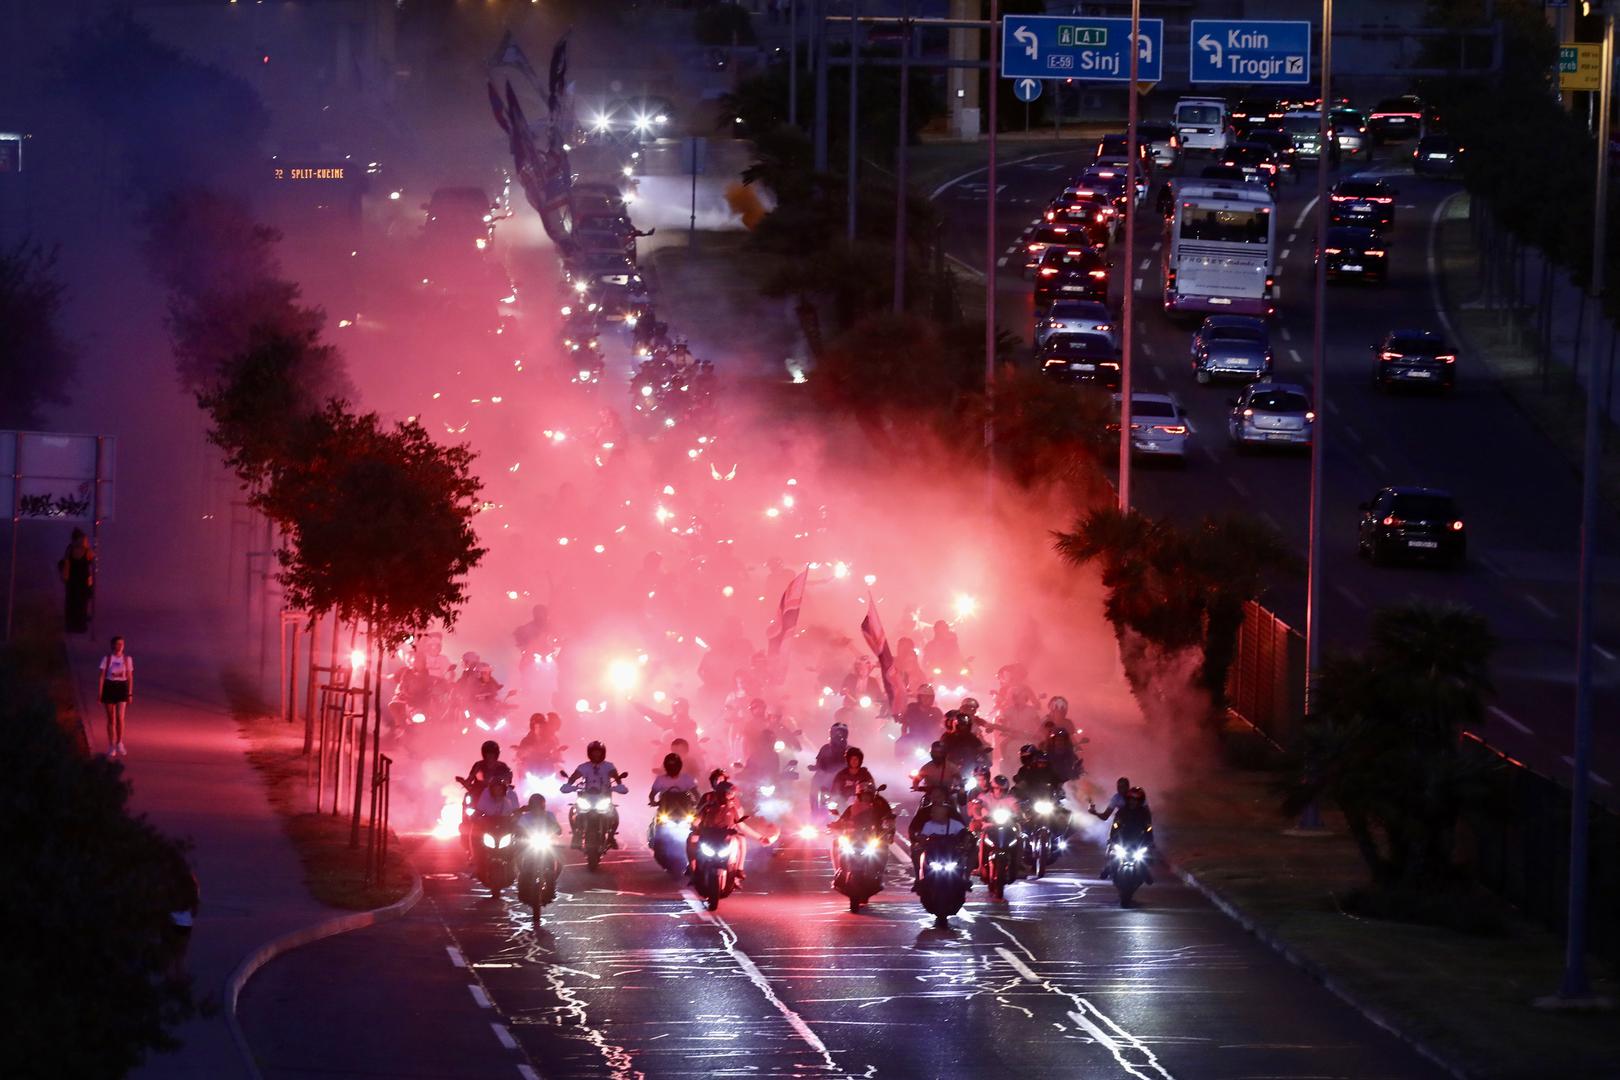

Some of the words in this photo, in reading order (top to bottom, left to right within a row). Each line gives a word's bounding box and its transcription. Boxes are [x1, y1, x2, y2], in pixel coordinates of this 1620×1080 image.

[1228, 30, 1268, 48] Knin
[1560, 49, 1574, 57] eka
[1081, 50, 1120, 75] Sinj
[1228, 55, 1284, 79] Trogir
[1559, 61, 1577, 71] greb
